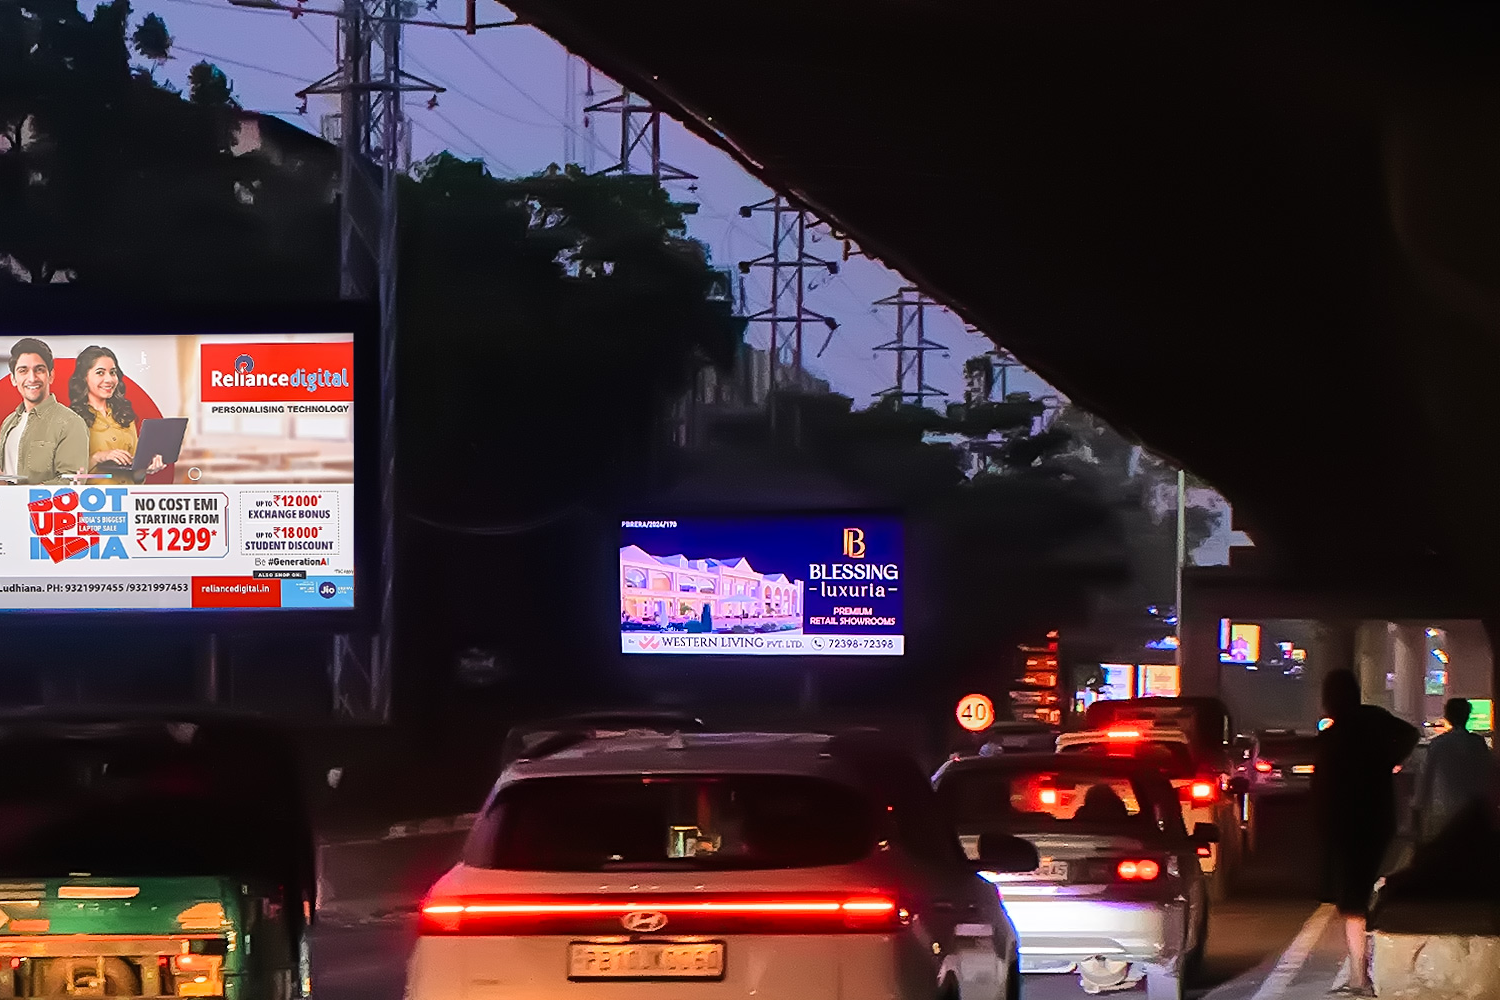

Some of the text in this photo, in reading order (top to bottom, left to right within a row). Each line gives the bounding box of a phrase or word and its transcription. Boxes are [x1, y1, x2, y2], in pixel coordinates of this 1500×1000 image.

[212, 405, 350, 414] PERSONALISING TECHNOLOGY
[28, 488, 128, 512] BOOT
[135, 498, 218, 511] NO COST EMI
[134, 514, 219, 524] STARTING FROM
[248, 510, 331, 519] EXCHANGE BONUS
[30, 536, 130, 562] INDIA
[245, 541, 334, 550] STUDENT DISCOUNT
[254, 558, 266, 566] Be
[809, 564, 898, 580] BLESSING
[46, 584, 64, 592] PH:
[65, 584, 124, 592] 9321997455
[201, 584, 270, 594] reliancedigital.in
[320, 586, 335, 594] Jio
[821, 582, 886, 598] luxuria
[833, 607, 872, 616] PREMIUM
[810, 617, 896, 626] RETAIL SHOWROOMS
[662, 636, 718, 647] WESTERN
[721, 638, 764, 648] LIVING
[767, 640, 785, 648] PVT.
[786, 640, 804, 648] LTD.
[828, 639, 894, 648] 72398-72398
[961, 704, 987, 721] 40
